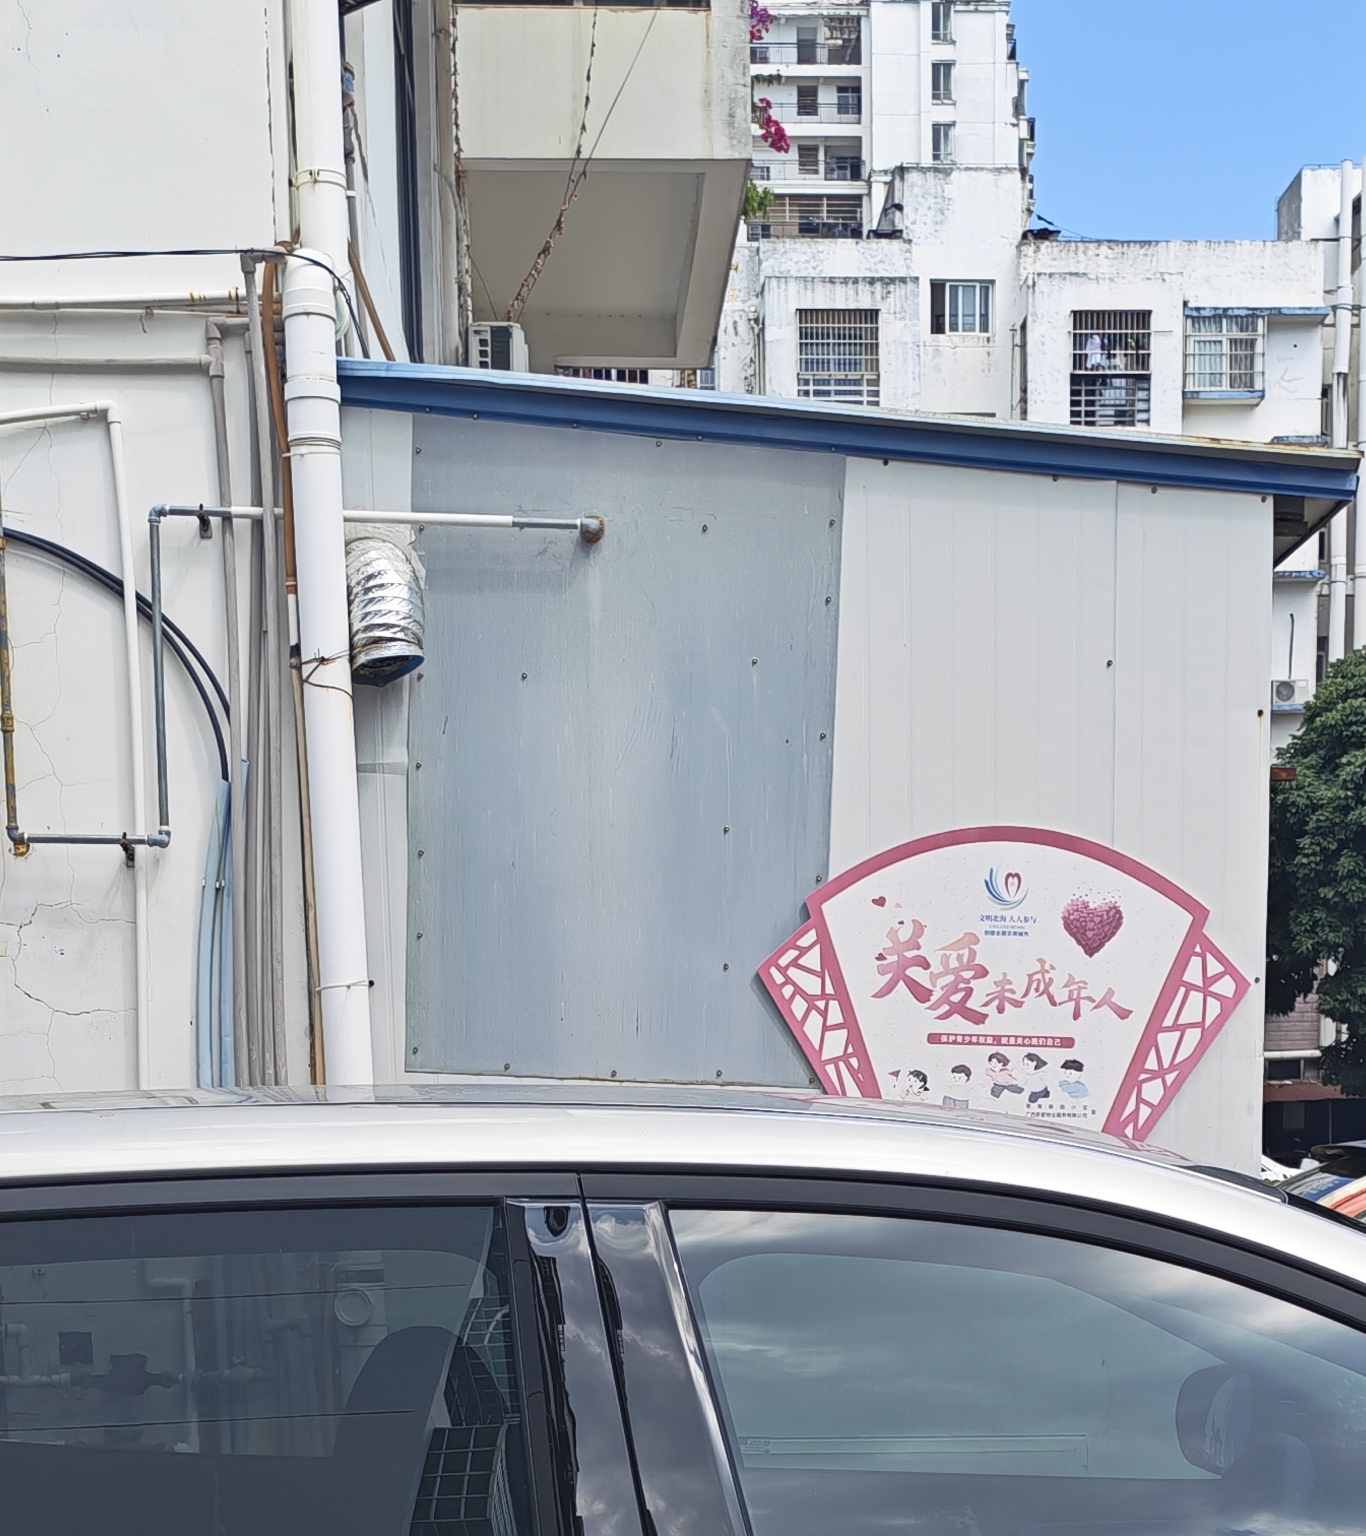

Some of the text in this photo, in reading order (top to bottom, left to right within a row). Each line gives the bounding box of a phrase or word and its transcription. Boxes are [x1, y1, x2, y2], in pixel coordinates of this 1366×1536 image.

[870, 919, 1134, 1026] 关爱未成年人
